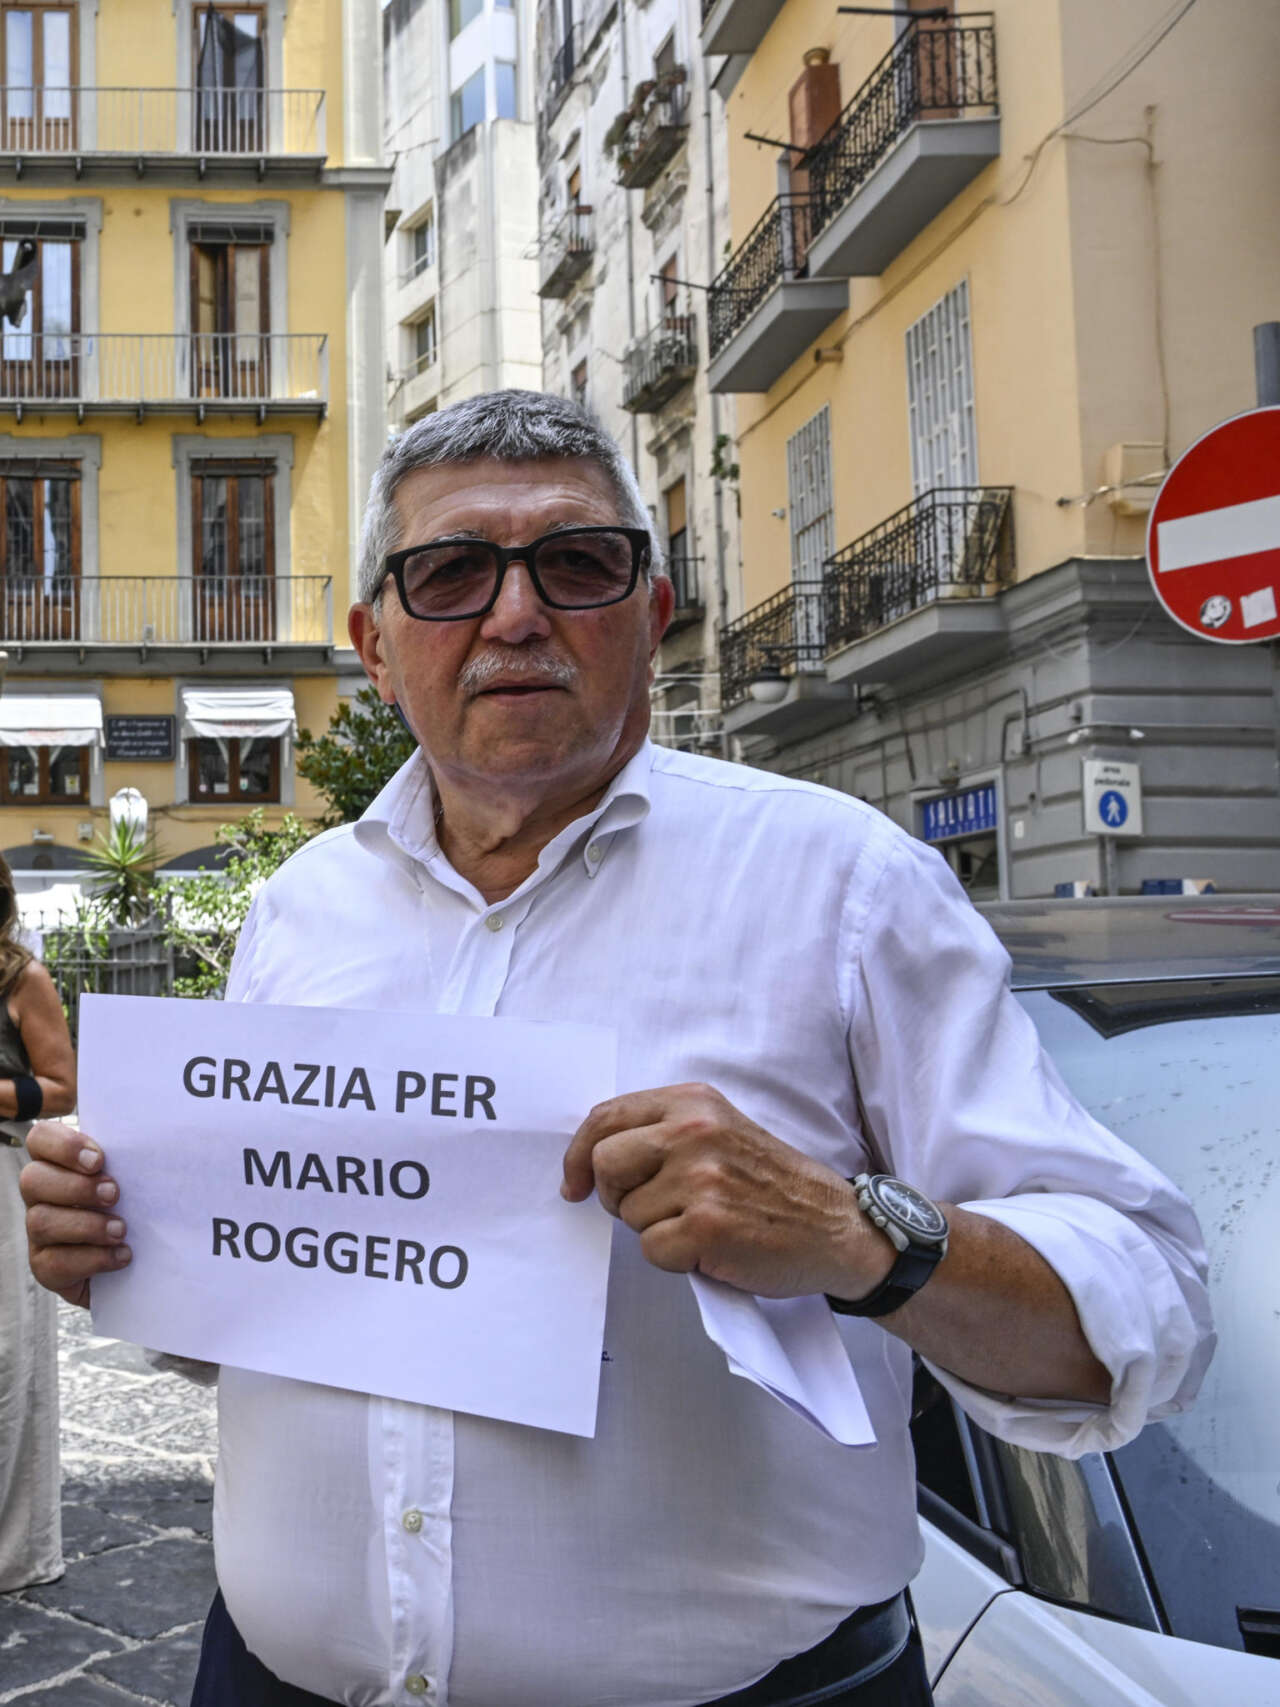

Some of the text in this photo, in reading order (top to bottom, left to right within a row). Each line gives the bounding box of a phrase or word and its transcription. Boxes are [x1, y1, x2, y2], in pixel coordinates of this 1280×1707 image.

[929, 789, 993, 829] SALVATI
[182, 1055, 497, 1121] GRAZIA PER
[242, 1147, 431, 1201] MARIO
[211, 1217, 469, 1290] ROGGERO
